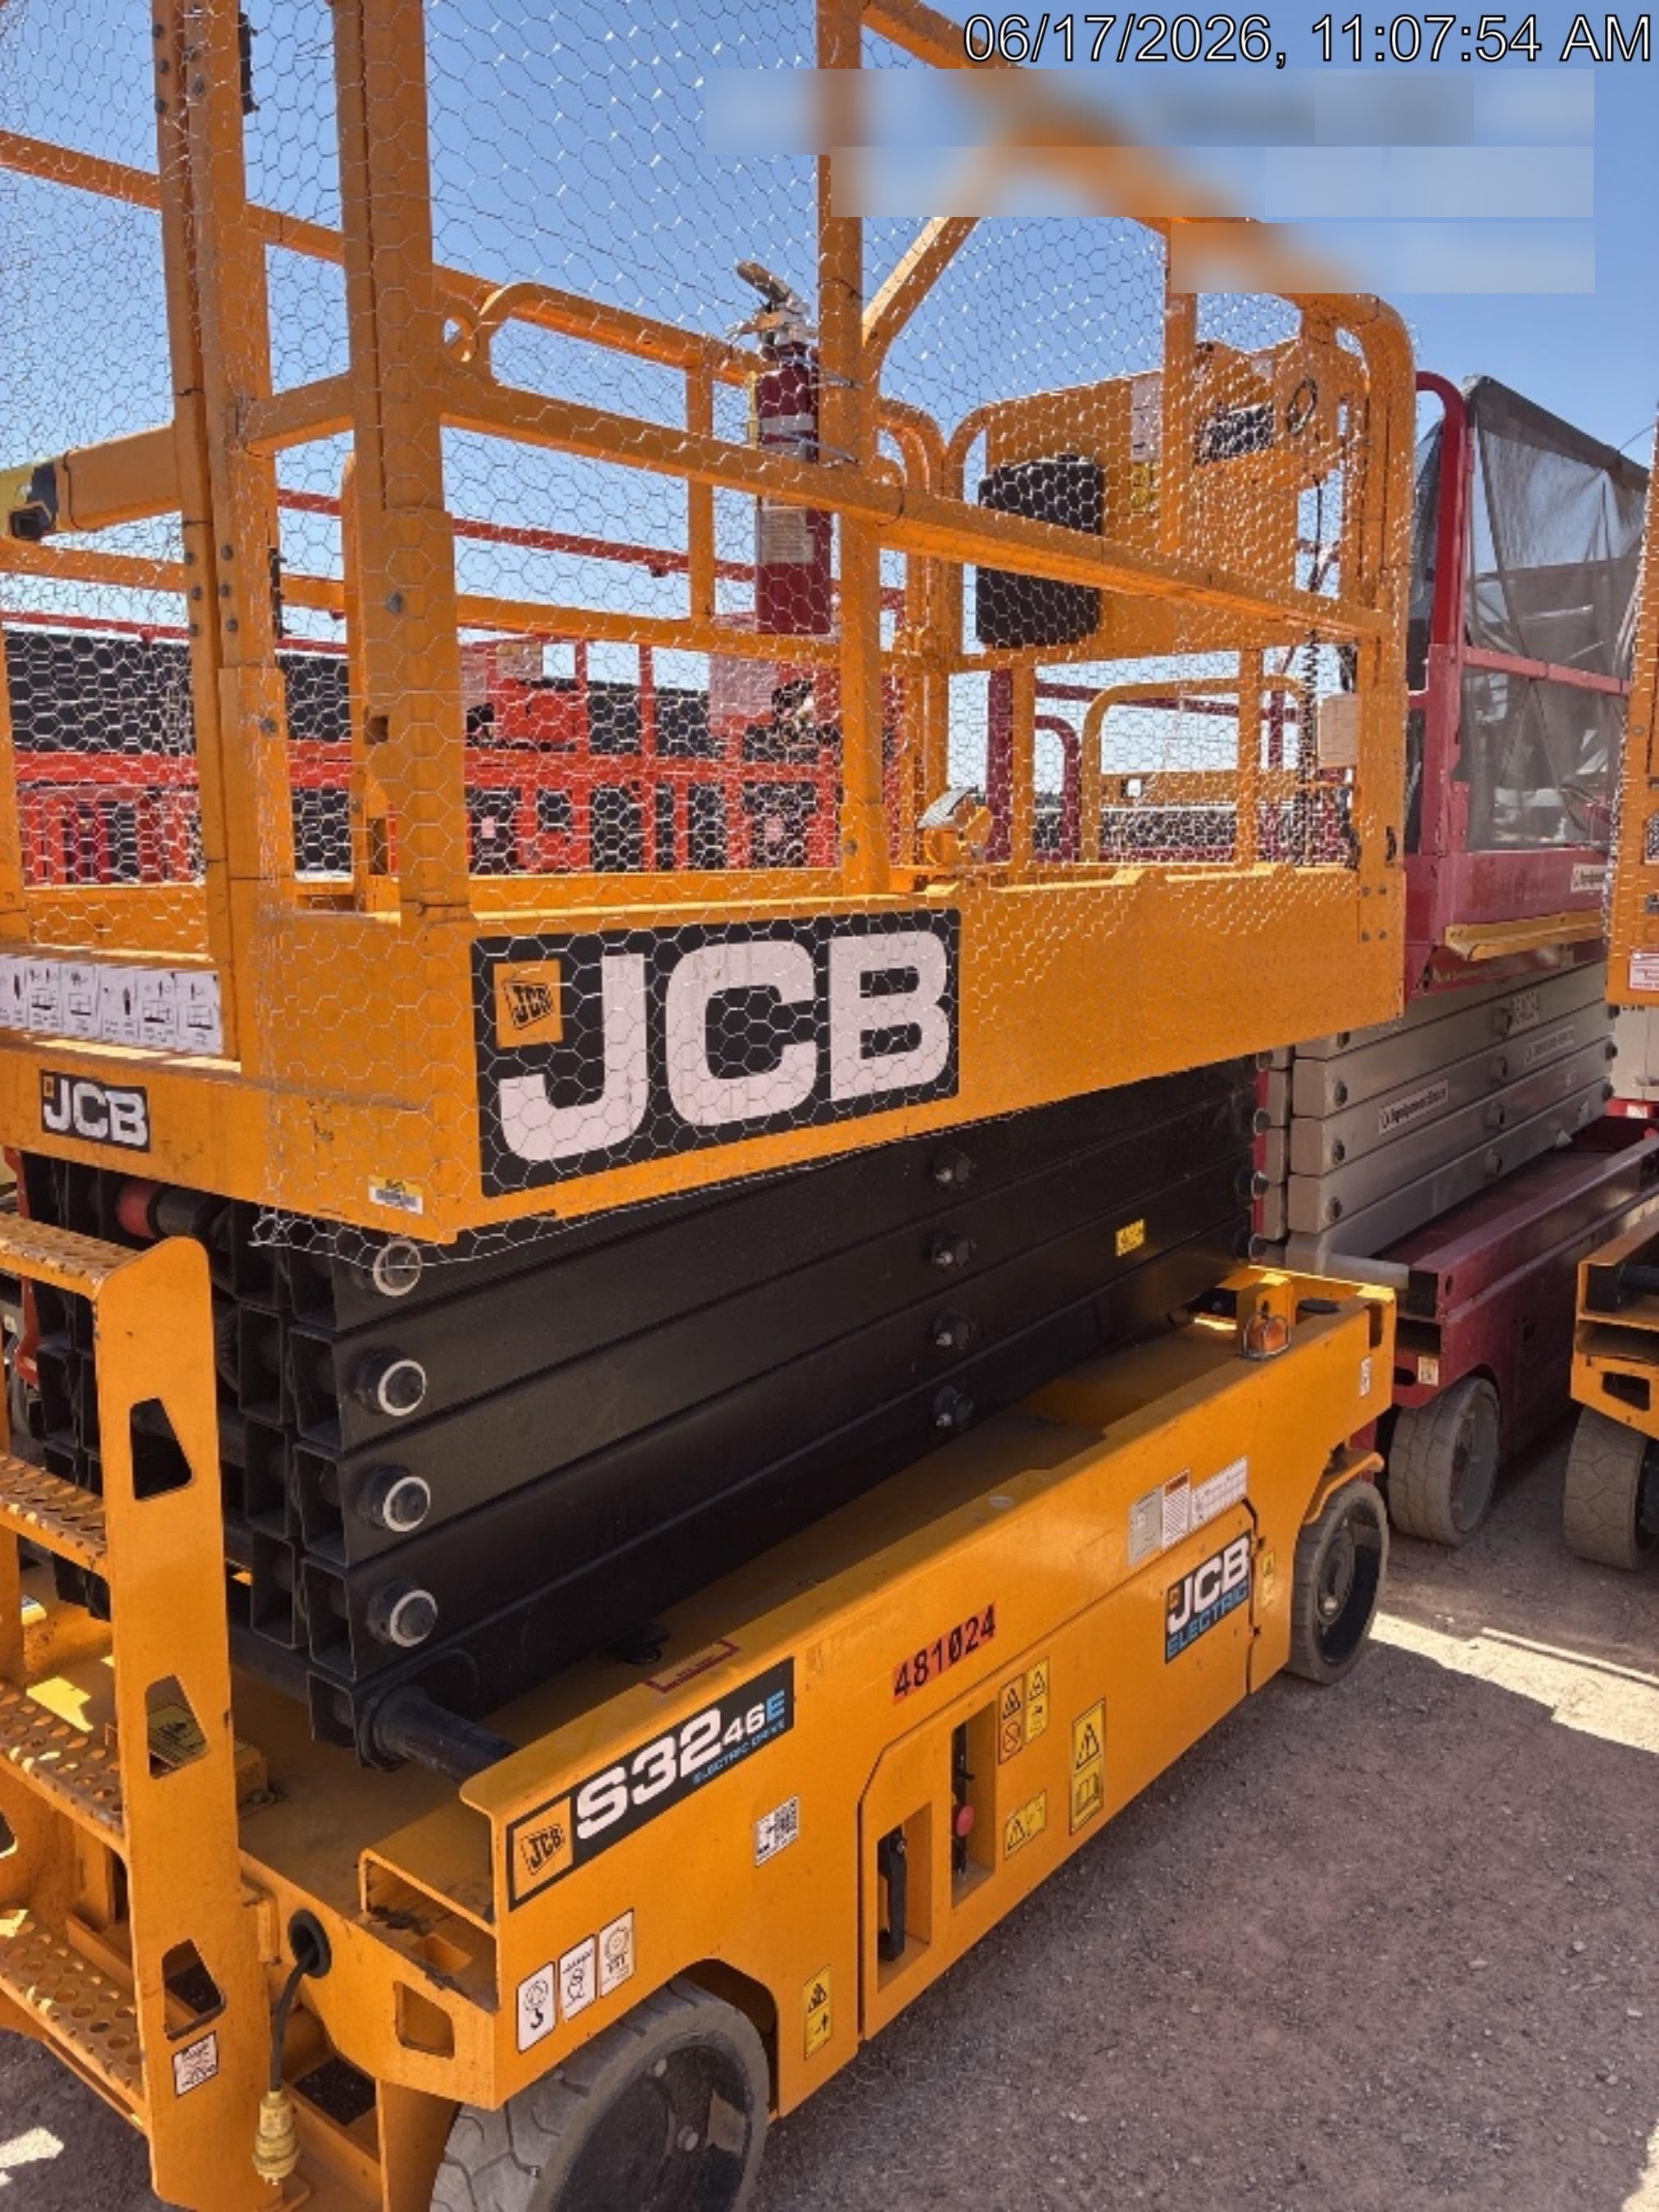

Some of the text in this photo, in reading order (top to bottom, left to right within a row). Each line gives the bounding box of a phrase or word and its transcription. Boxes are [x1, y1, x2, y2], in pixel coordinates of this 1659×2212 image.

[498, 931, 950, 1161] JCB
[43, 1077, 148, 1146] JCB
[1167, 1535, 1250, 1634] JCB
[1167, 1582, 1249, 1660] ELECTRIC
[894, 1604, 995, 1698] 481024
[692, 1742, 750, 1785] ELECTRIC
[528, 1827, 562, 1869] JCB
